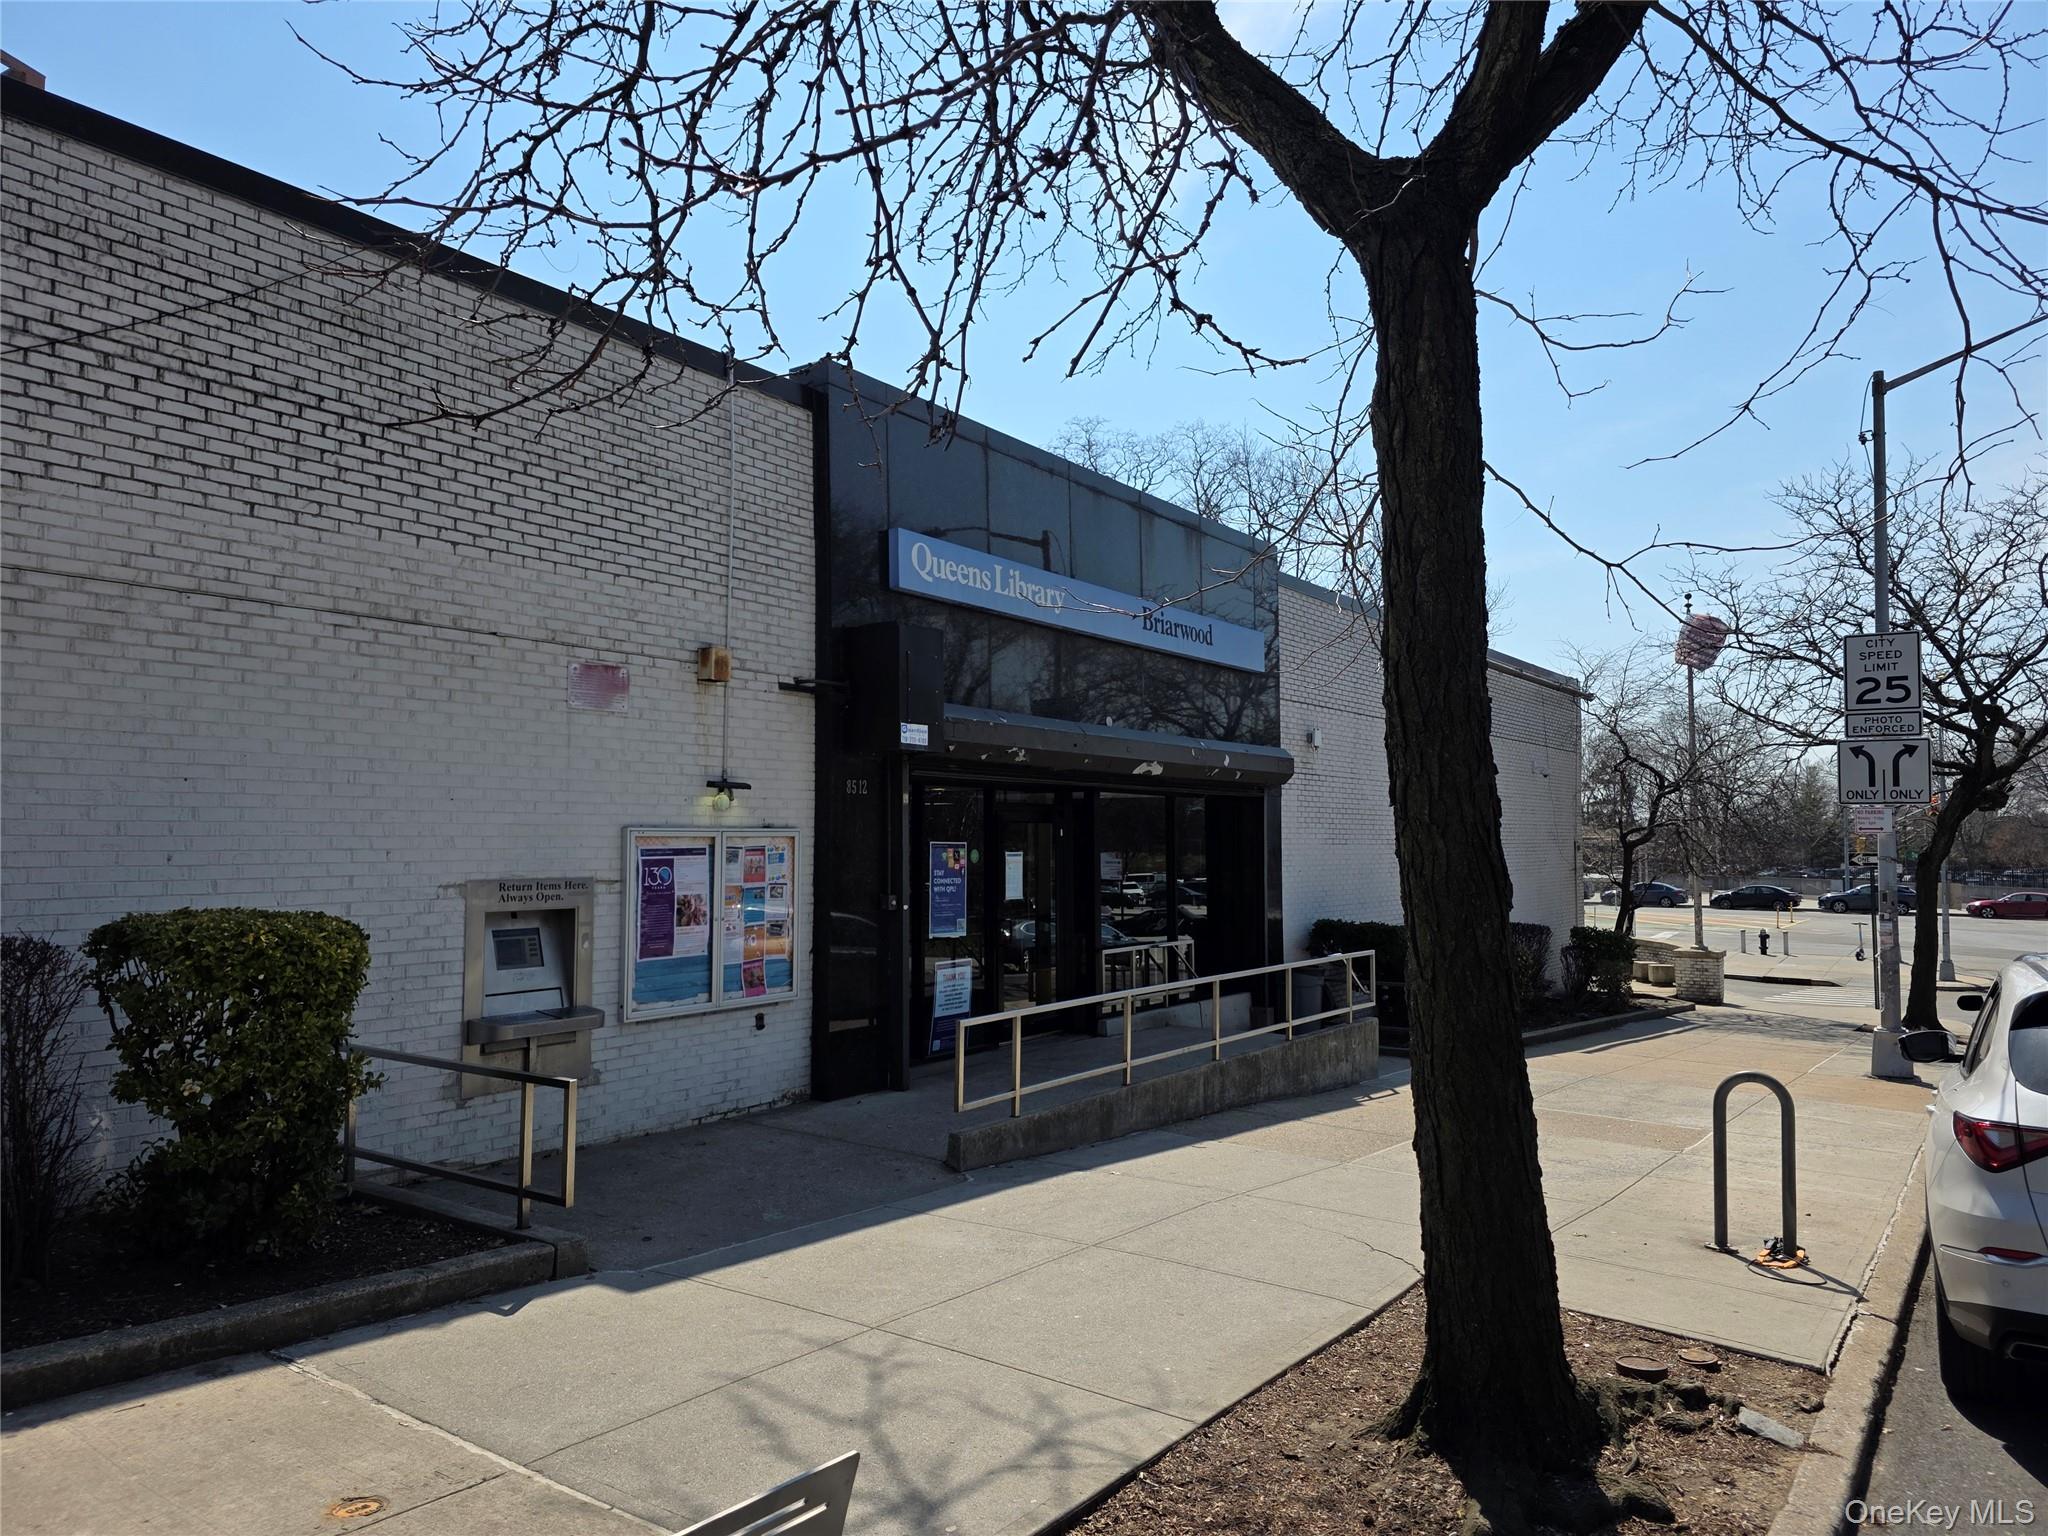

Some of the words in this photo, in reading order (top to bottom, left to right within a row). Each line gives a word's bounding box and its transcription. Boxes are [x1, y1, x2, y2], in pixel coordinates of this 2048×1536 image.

[911, 541, 992, 592] Queens
[994, 563, 1066, 615] Library
[1142, 605, 1214, 647] Briarwood
[1865, 638, 1896, 649] CITY
[1859, 650, 1903, 661] SPEED
[1864, 662, 1899, 673] LIMIT
[1855, 675, 1912, 705] 25
[1864, 715, 1903, 725] PHOTO
[1852, 724, 1915, 734] ENFORCED
[1846, 789, 1880, 800] ONLY
[1890, 789, 1924, 800] ONLY
[643, 866, 673, 887] 130
[933, 877, 962, 885] CONNECTED
[498, 882, 533, 892] Return
[535, 881, 562, 891] Items
[564, 880, 589, 890] Here.
[933, 885, 946, 893] WITH
[498, 892, 534, 904] Always
[536, 891, 564, 904] Open.
